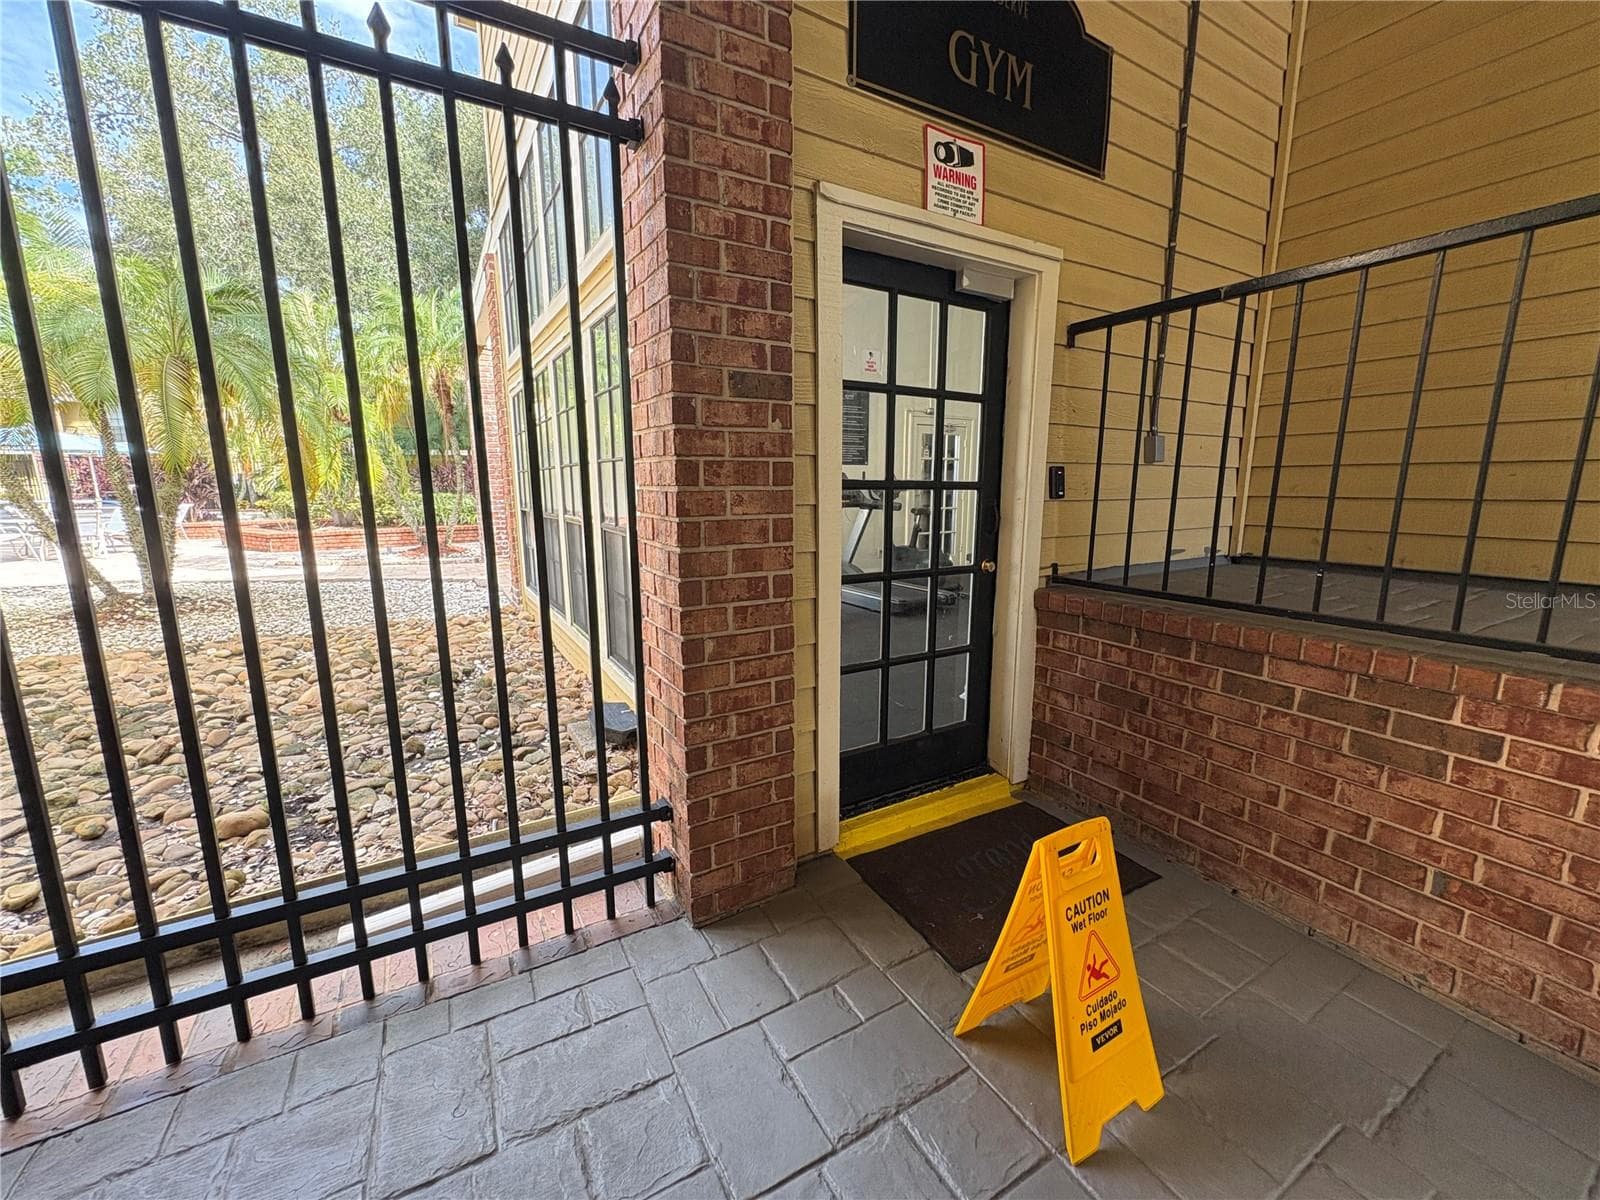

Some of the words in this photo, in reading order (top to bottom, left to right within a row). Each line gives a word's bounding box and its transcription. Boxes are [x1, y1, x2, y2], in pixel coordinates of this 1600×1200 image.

[949, 29, 1034, 111] GYM
[933, 163, 977, 190] WARNING
[1065, 887, 1110, 922] CAUTION
[1071, 917, 1087, 935] Wet
[1088, 907, 1108, 926] Floor
[1080, 1017, 1098, 1036] Piso
[1099, 997, 1127, 1023] Mojado
[1086, 989, 1118, 1017] Cuidado
[1095, 1024, 1119, 1046] VEVOR
